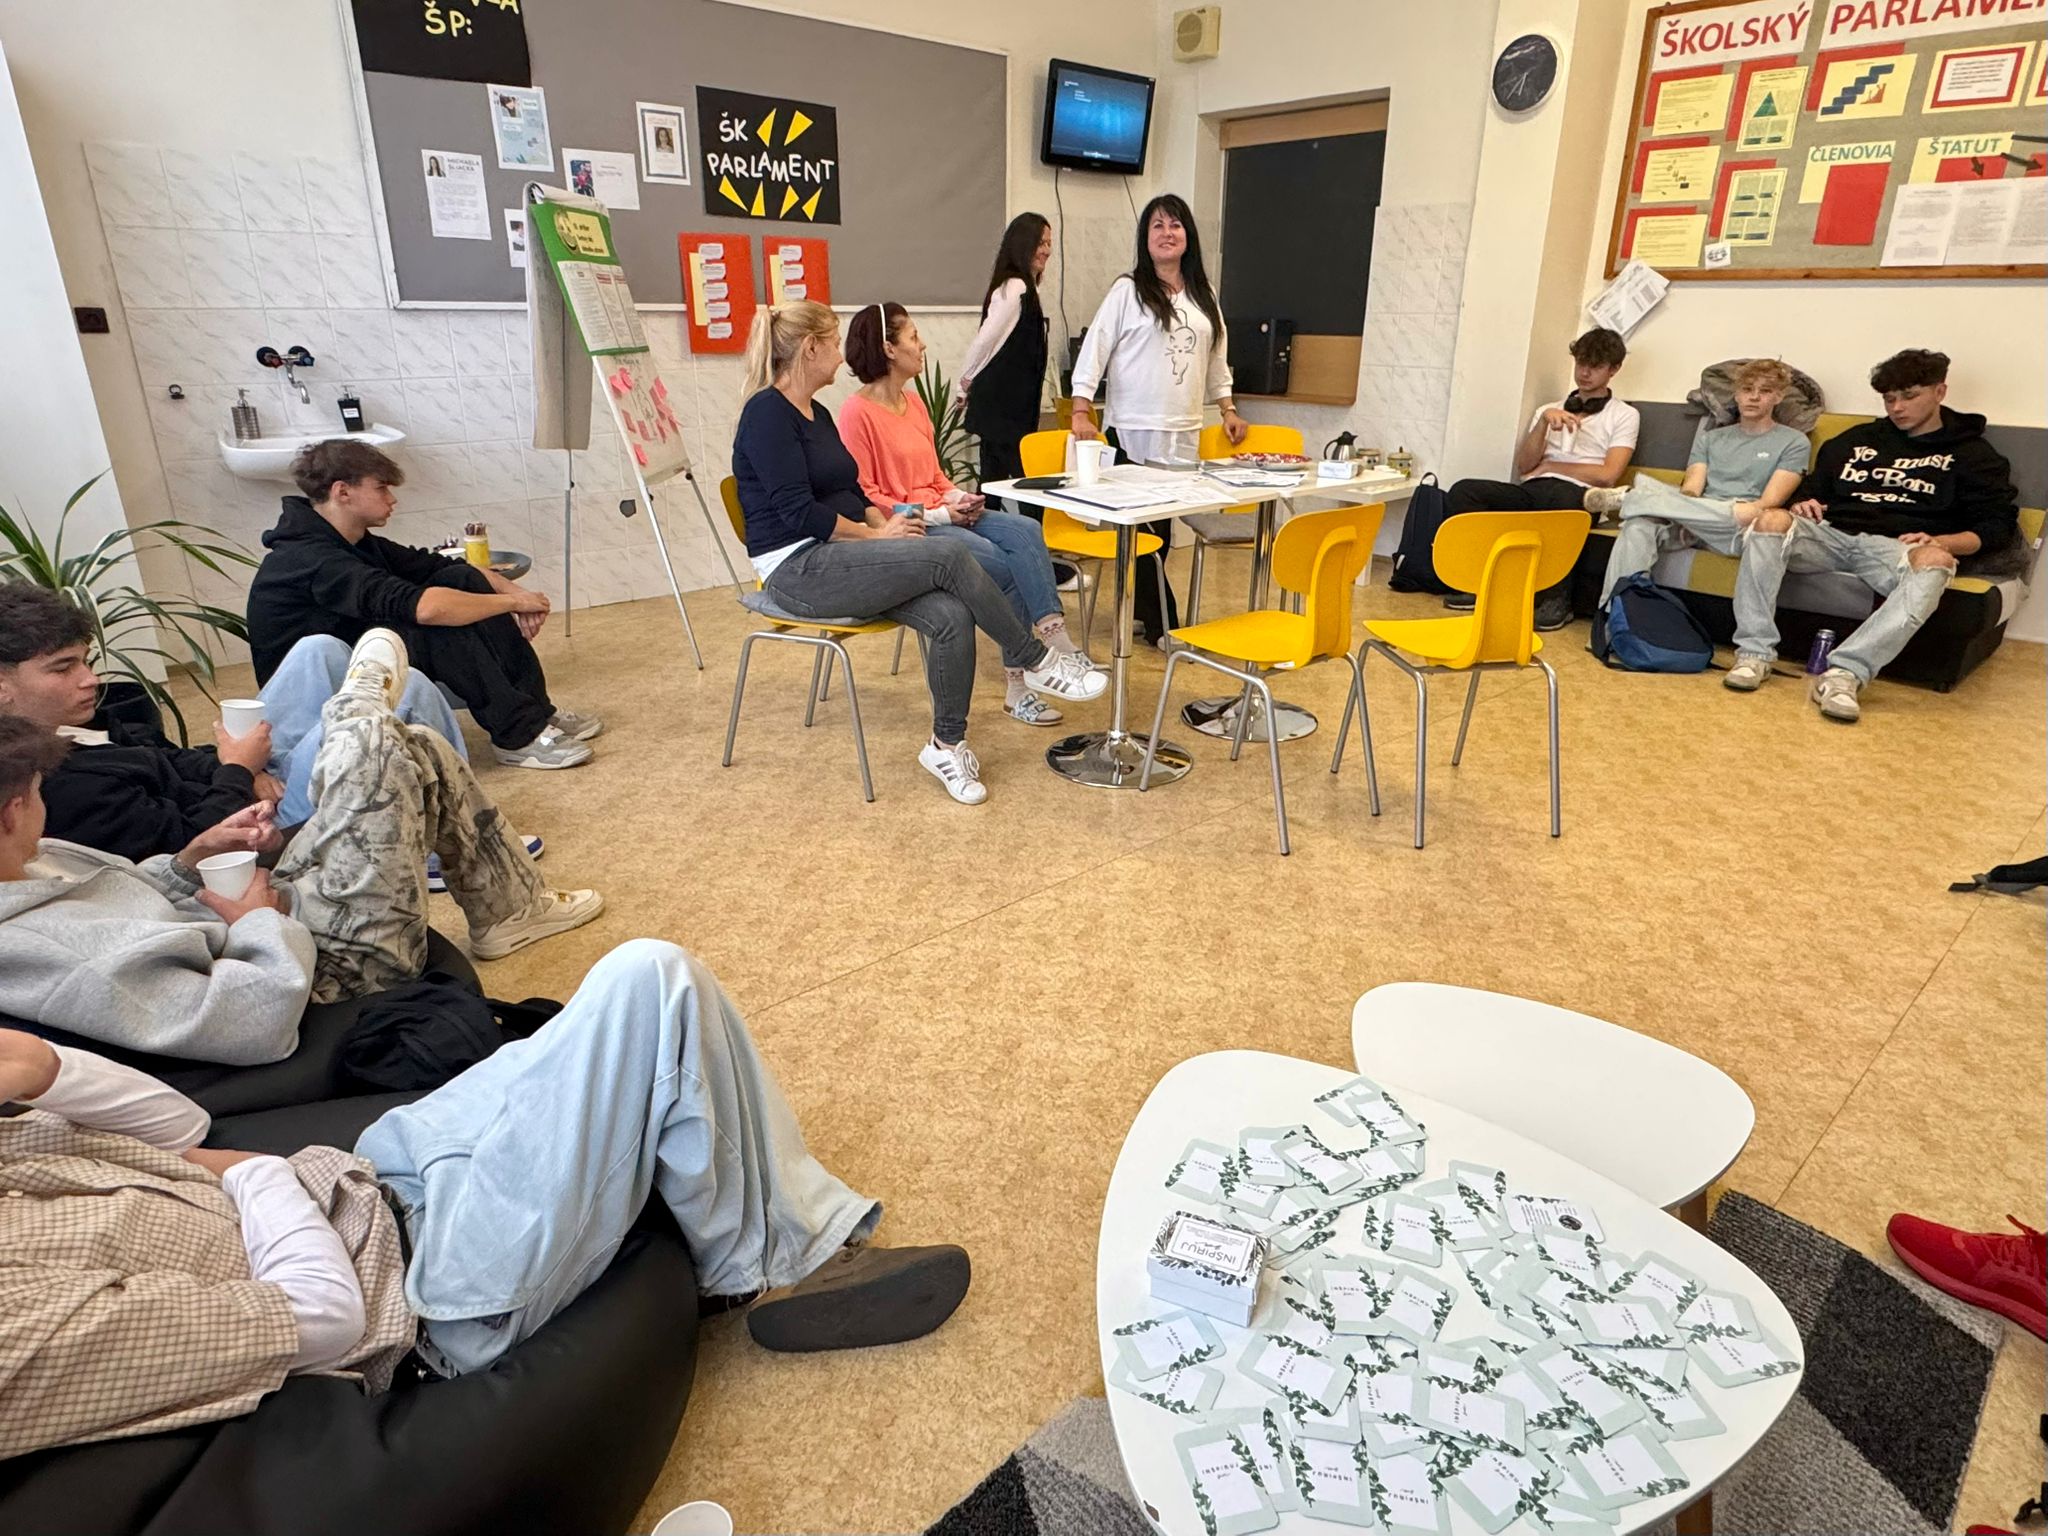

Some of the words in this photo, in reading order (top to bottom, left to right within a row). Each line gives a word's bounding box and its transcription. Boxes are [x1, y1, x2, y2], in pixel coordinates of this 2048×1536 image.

[424, 1, 473, 37] ŠP:
[1660, 2, 1810, 57] ŠKOLSKÝ
[718, 111, 748, 143] ŠK
[1810, 143, 1893, 162] ČLENOVIA
[1928, 136, 2001, 156] ŠTATUT
[706, 151, 835, 184] PARLAMENT
[1849, 446, 1878, 463] ye
[1892, 453, 1955, 472] must
[1840, 463, 1869, 483] be
[1872, 467, 1936, 494] Born
